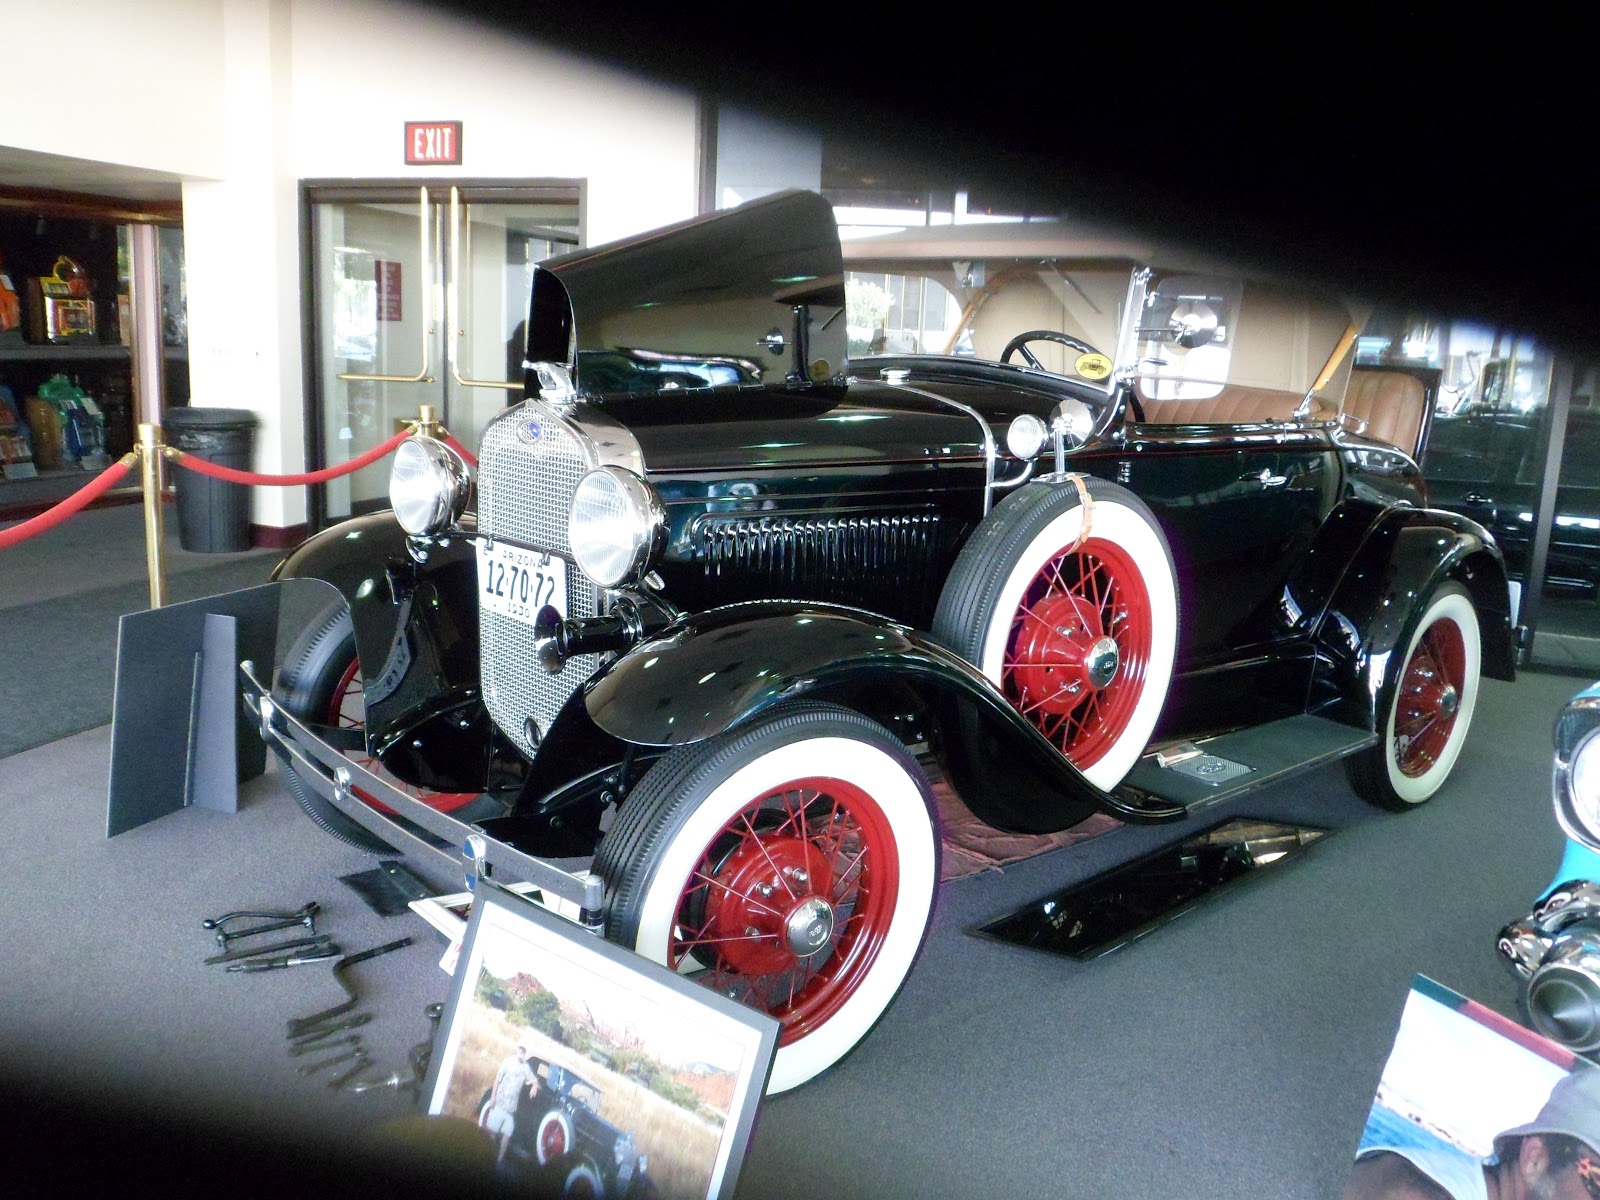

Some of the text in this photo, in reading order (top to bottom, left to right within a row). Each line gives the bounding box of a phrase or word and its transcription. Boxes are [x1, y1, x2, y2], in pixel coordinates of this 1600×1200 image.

[414, 128, 452, 159] EXIT
[502, 550, 543, 569] ARIZONA
[507, 602, 530, 618] 1930
